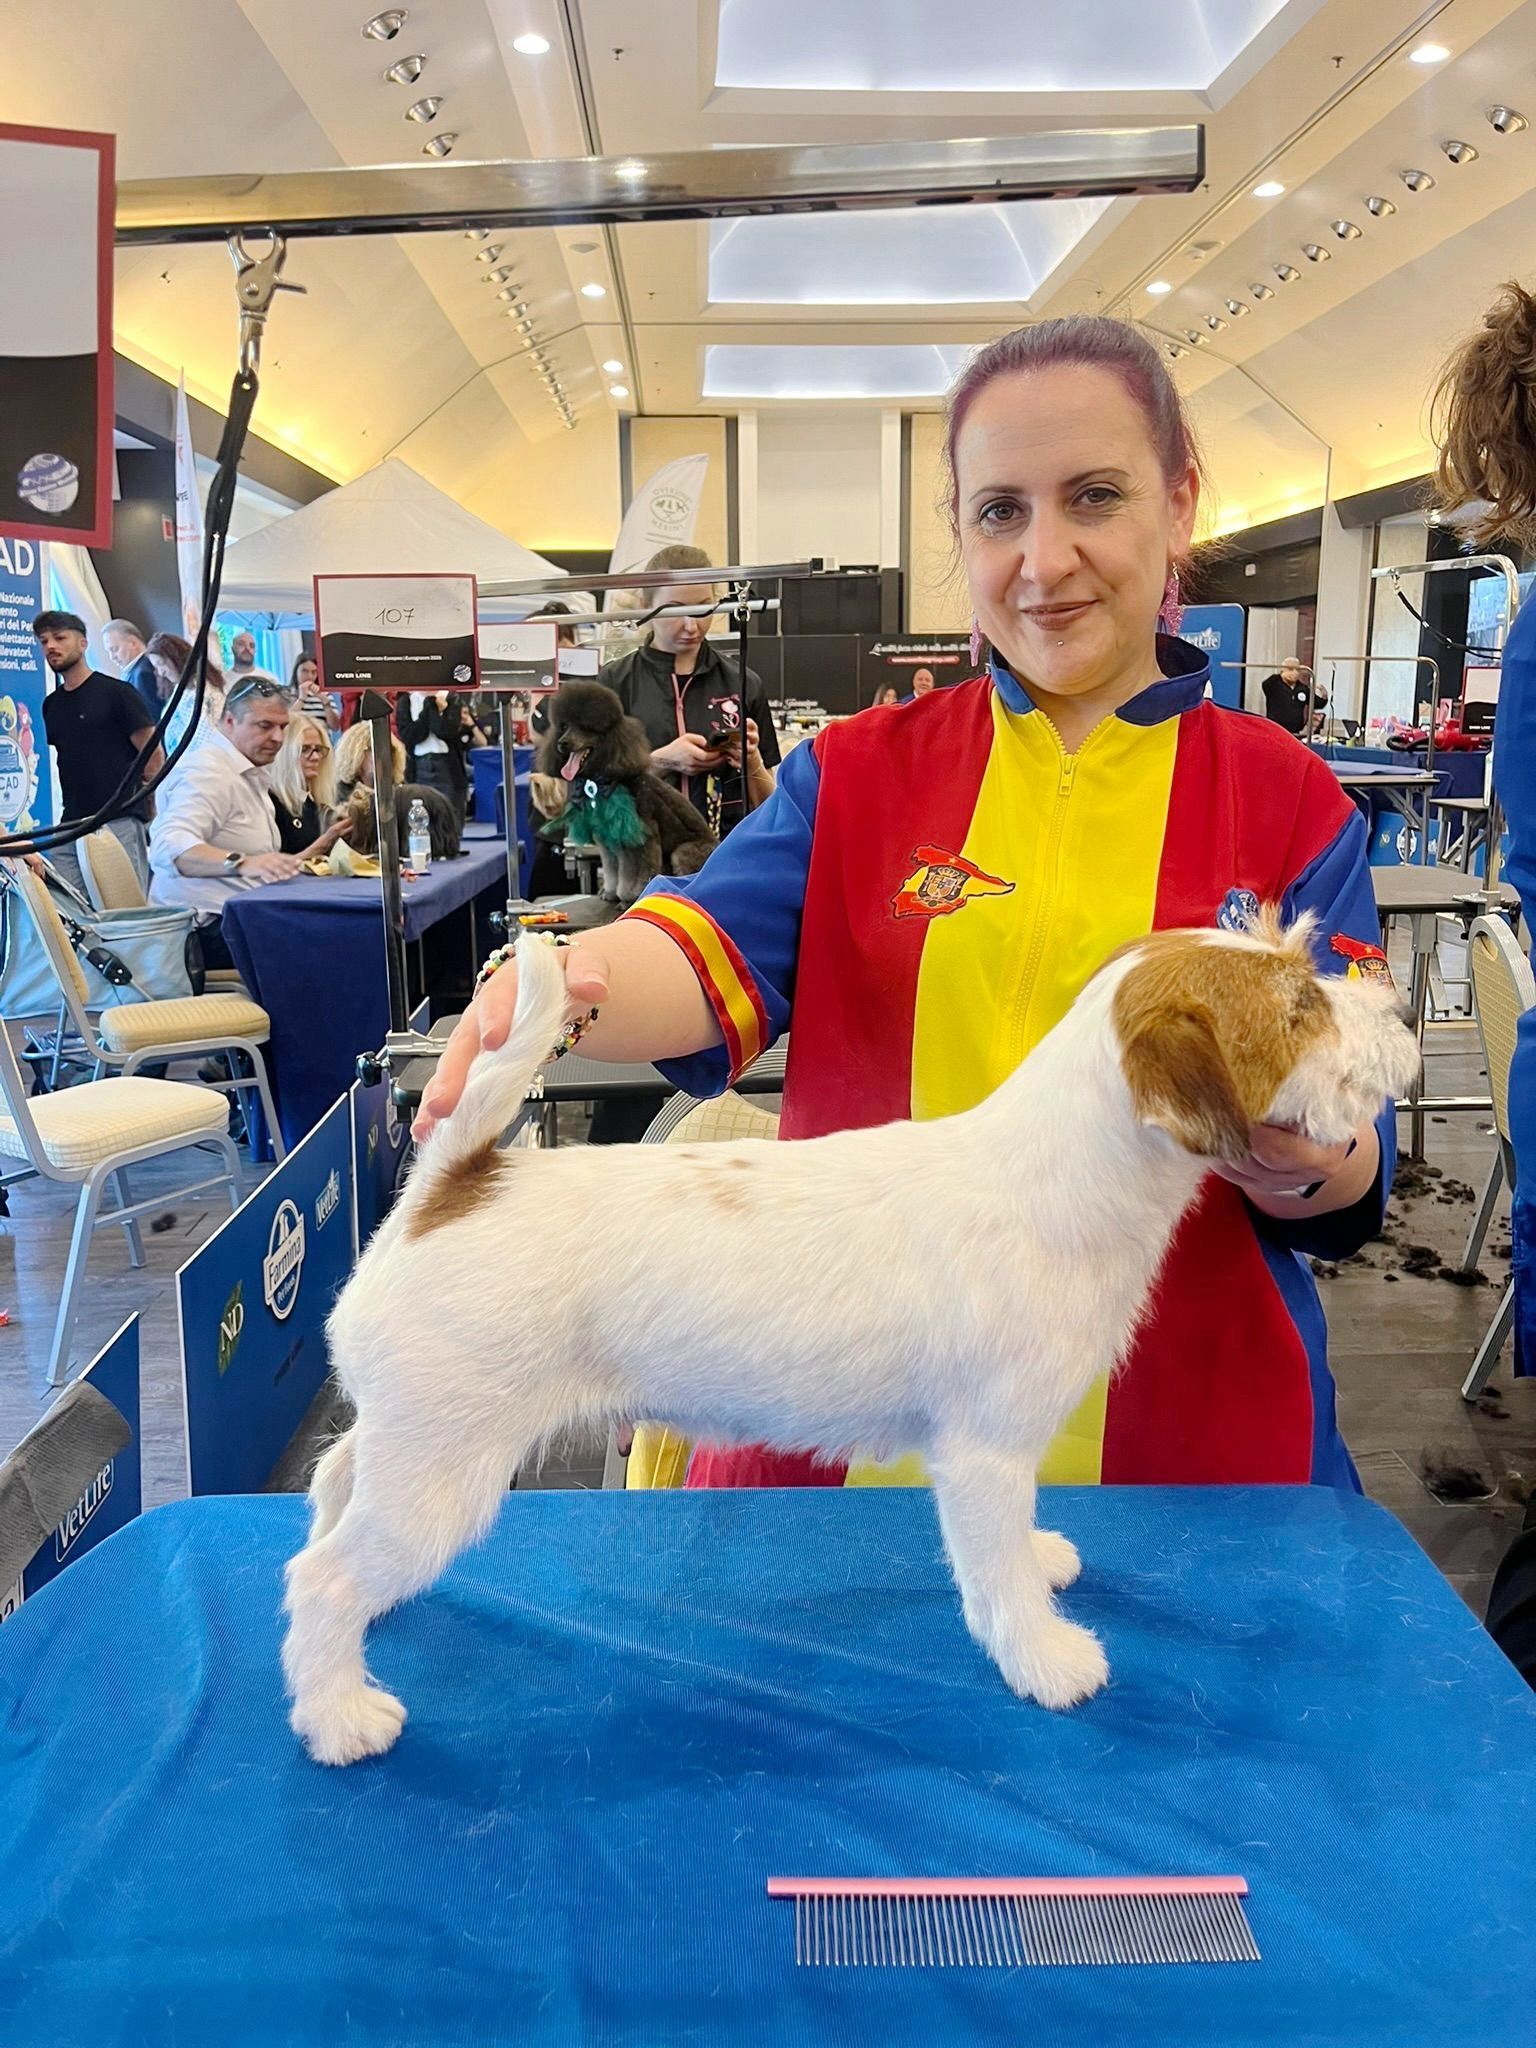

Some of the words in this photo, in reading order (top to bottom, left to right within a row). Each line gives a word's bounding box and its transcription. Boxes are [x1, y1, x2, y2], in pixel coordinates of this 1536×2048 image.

[374, 607, 415, 626] 107
[495, 643, 519, 653] 120
[268, 1235, 302, 1290] Farmina
[220, 1303, 245, 1351] ND
[57, 1464, 111, 1549] VetLife
